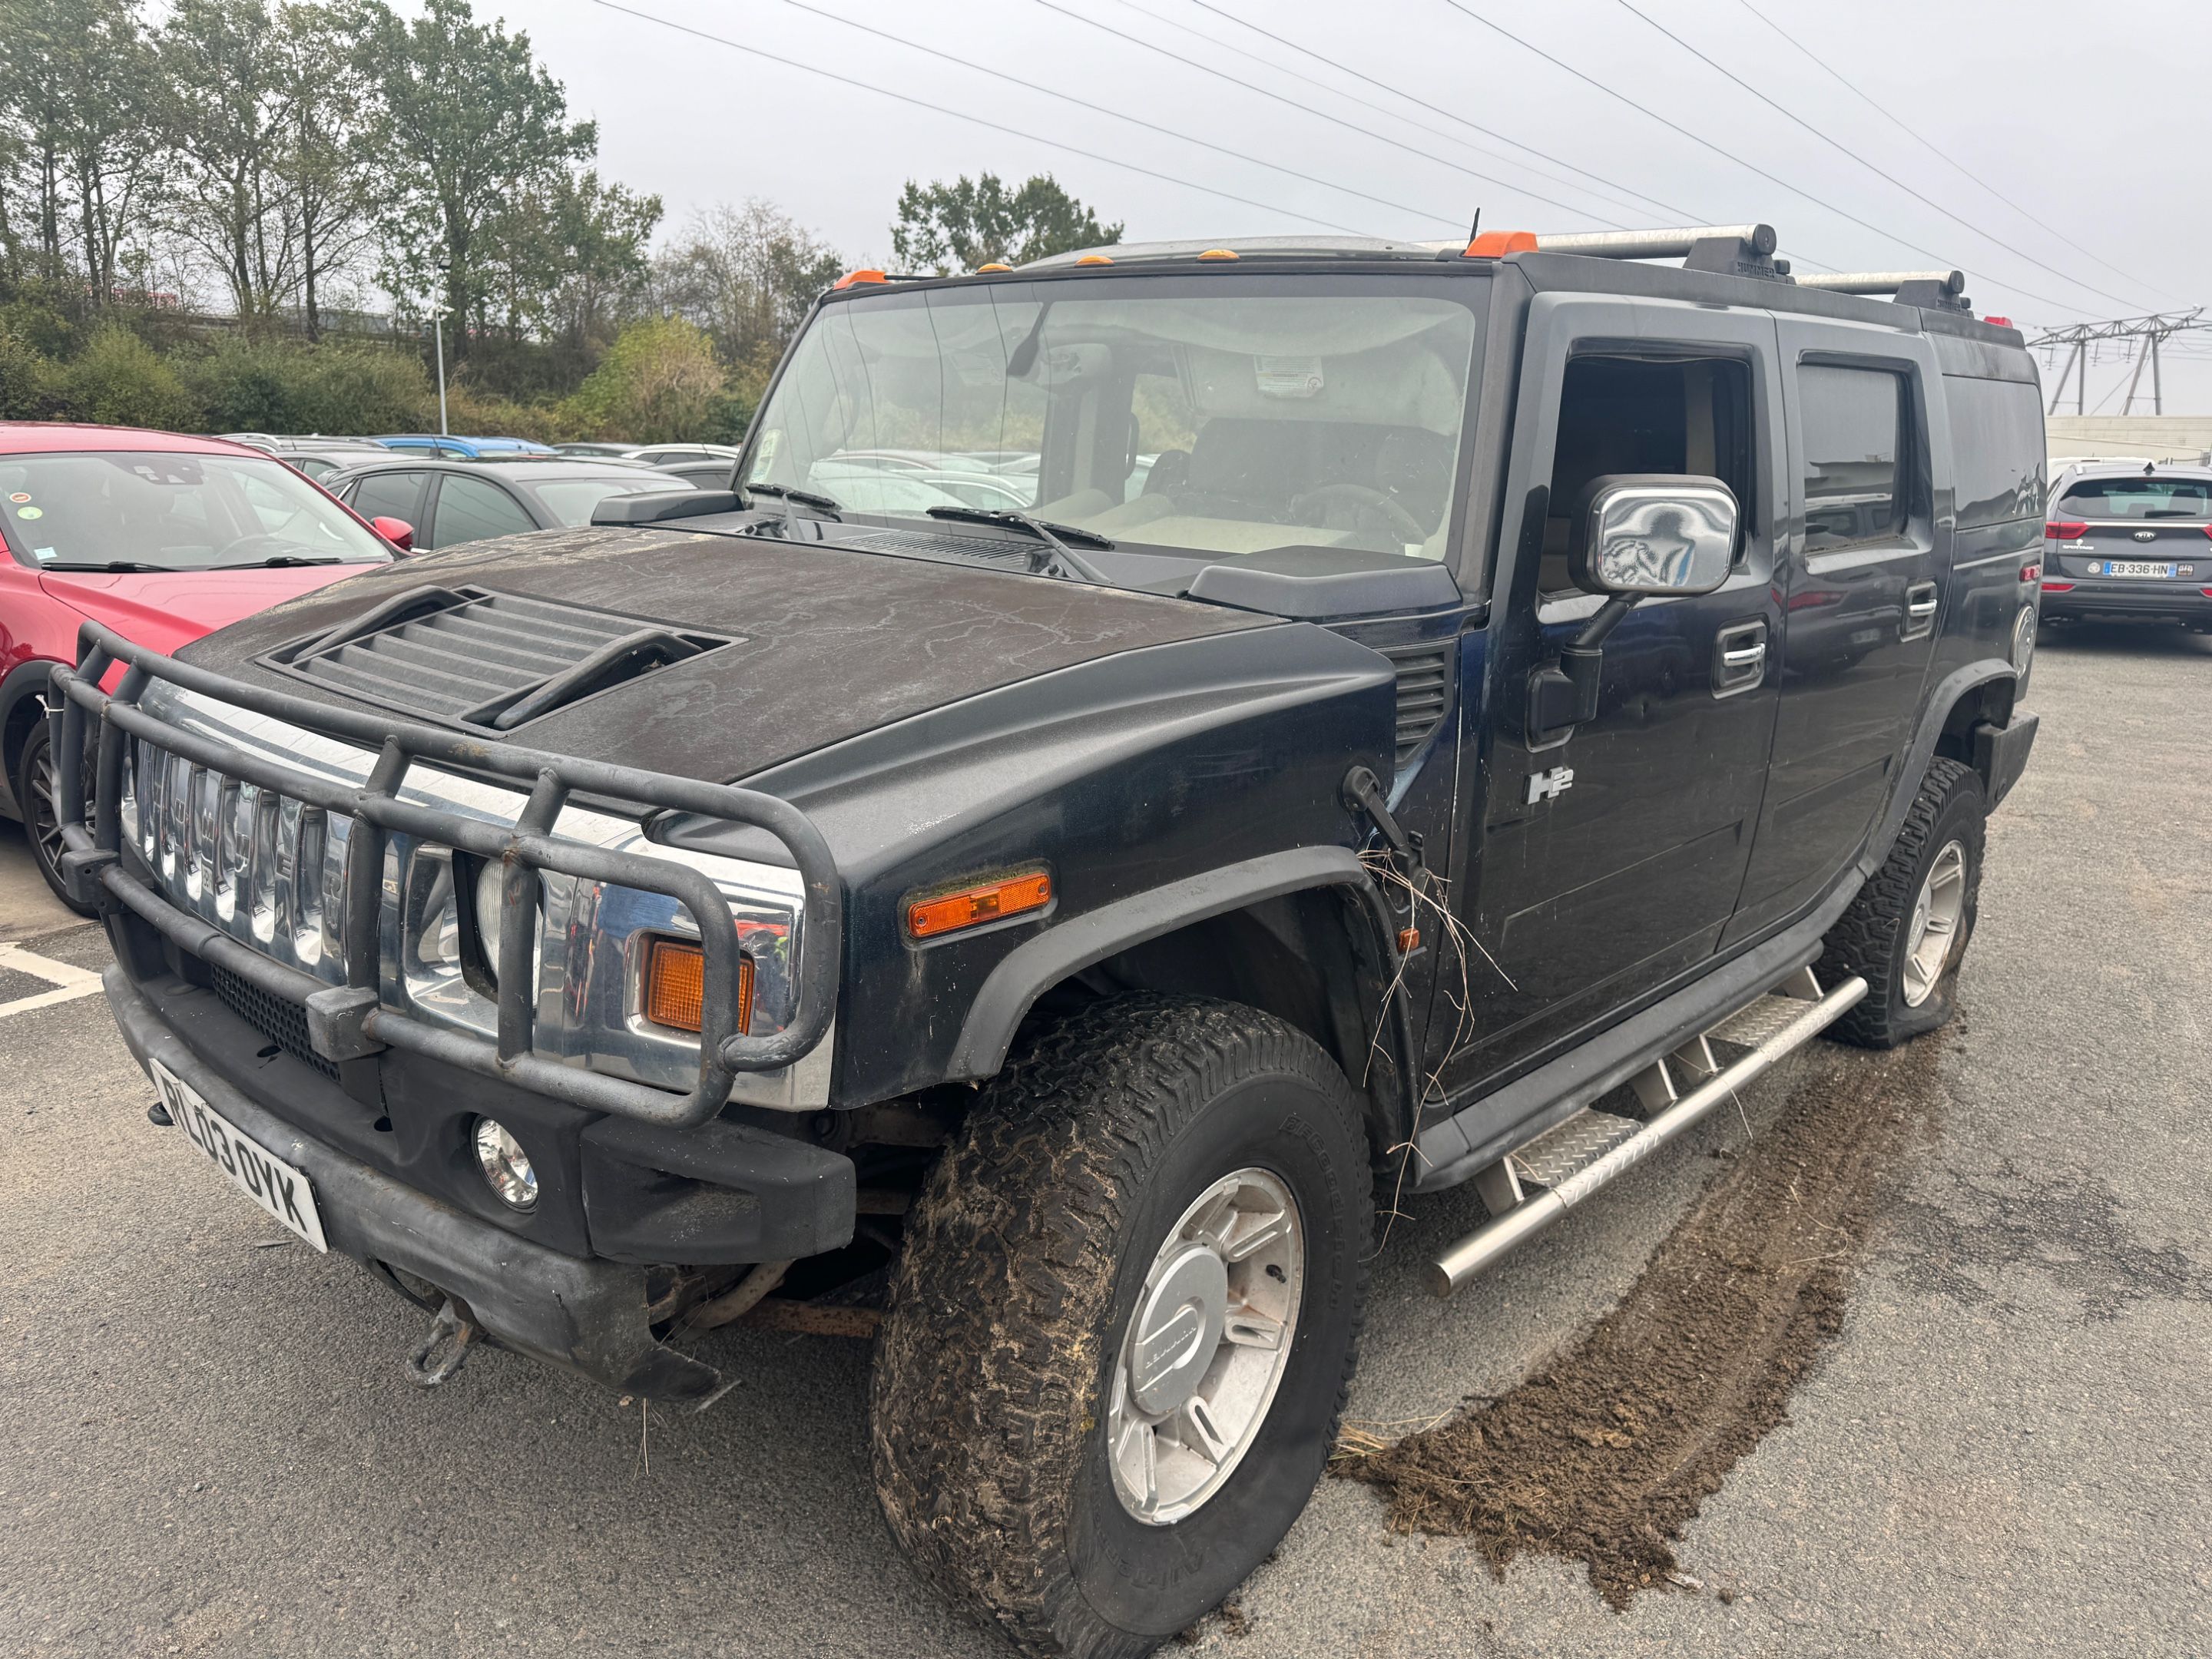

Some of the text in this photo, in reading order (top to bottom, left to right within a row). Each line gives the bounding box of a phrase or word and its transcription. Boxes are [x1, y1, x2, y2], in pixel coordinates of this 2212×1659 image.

[1737, 262, 1774, 278] HUMMER
[1522, 766, 1574, 806] H2
[235, 1140, 308, 1234] OYK
